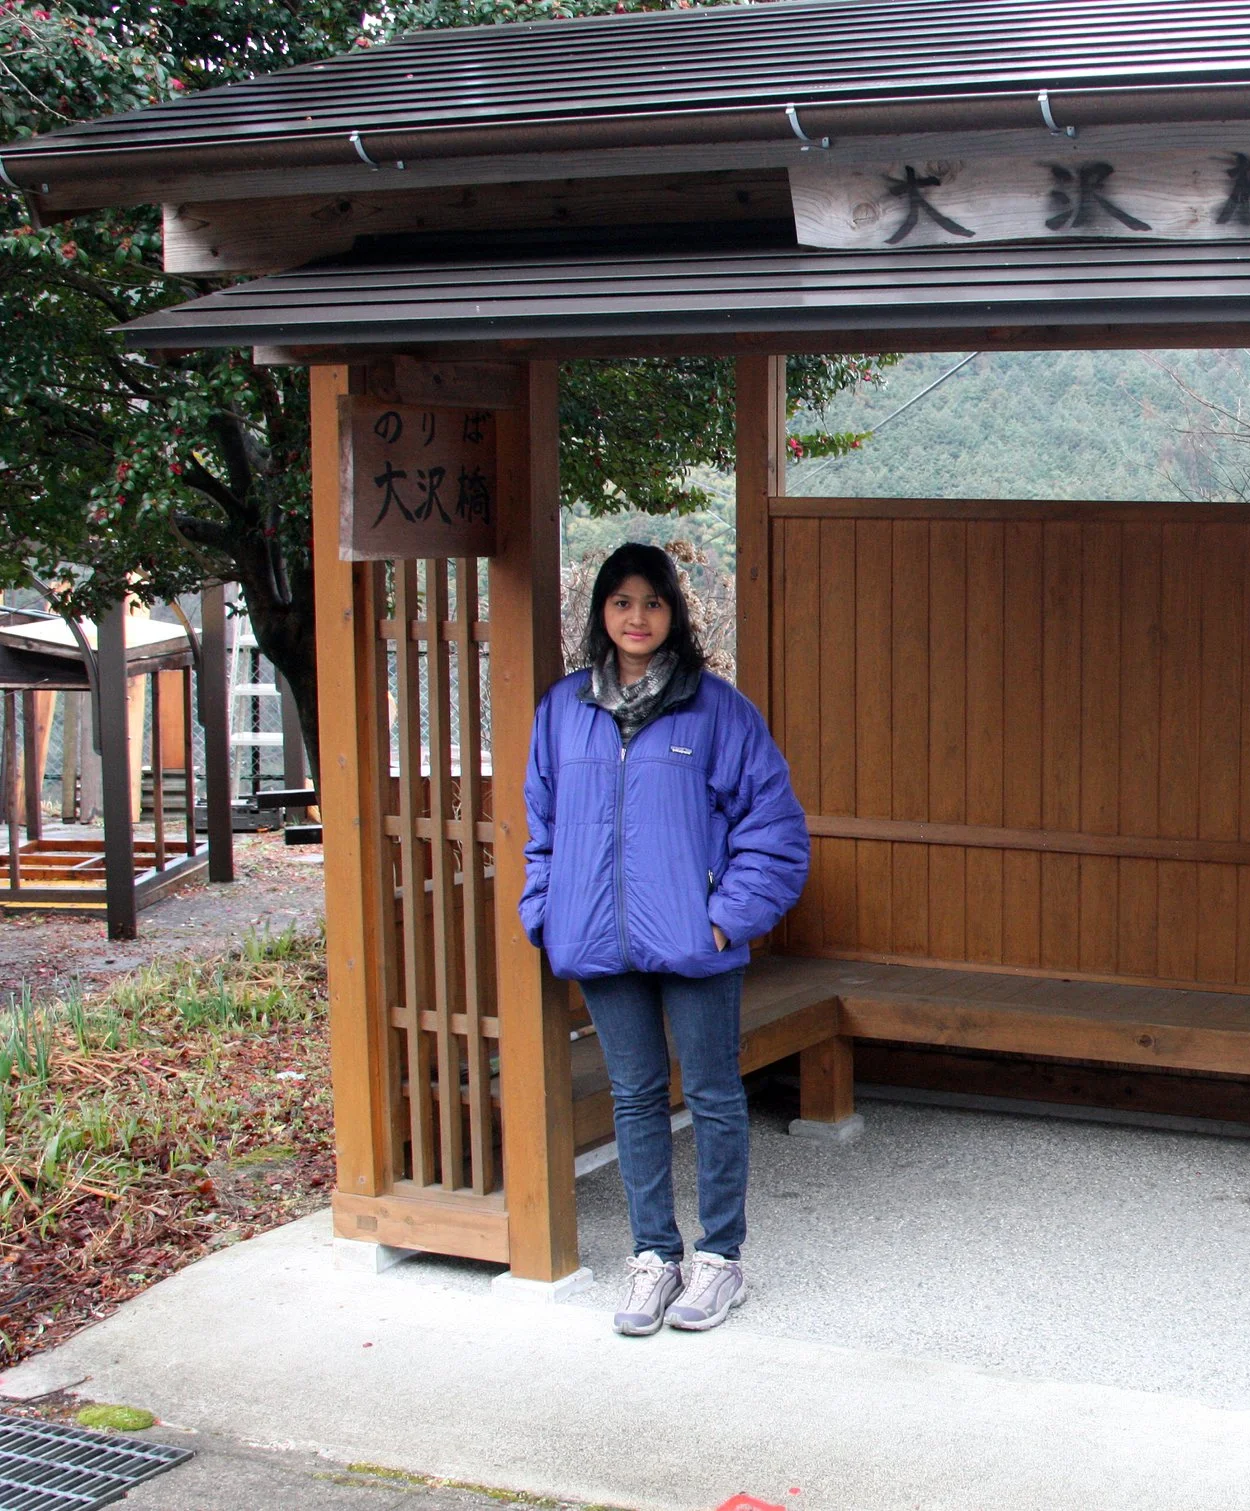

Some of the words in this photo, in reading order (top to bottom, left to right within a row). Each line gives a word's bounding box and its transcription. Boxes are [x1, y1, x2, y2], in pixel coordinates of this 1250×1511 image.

[373, 410, 492, 446] のりば
[371, 461, 491, 529] 大沢橋
